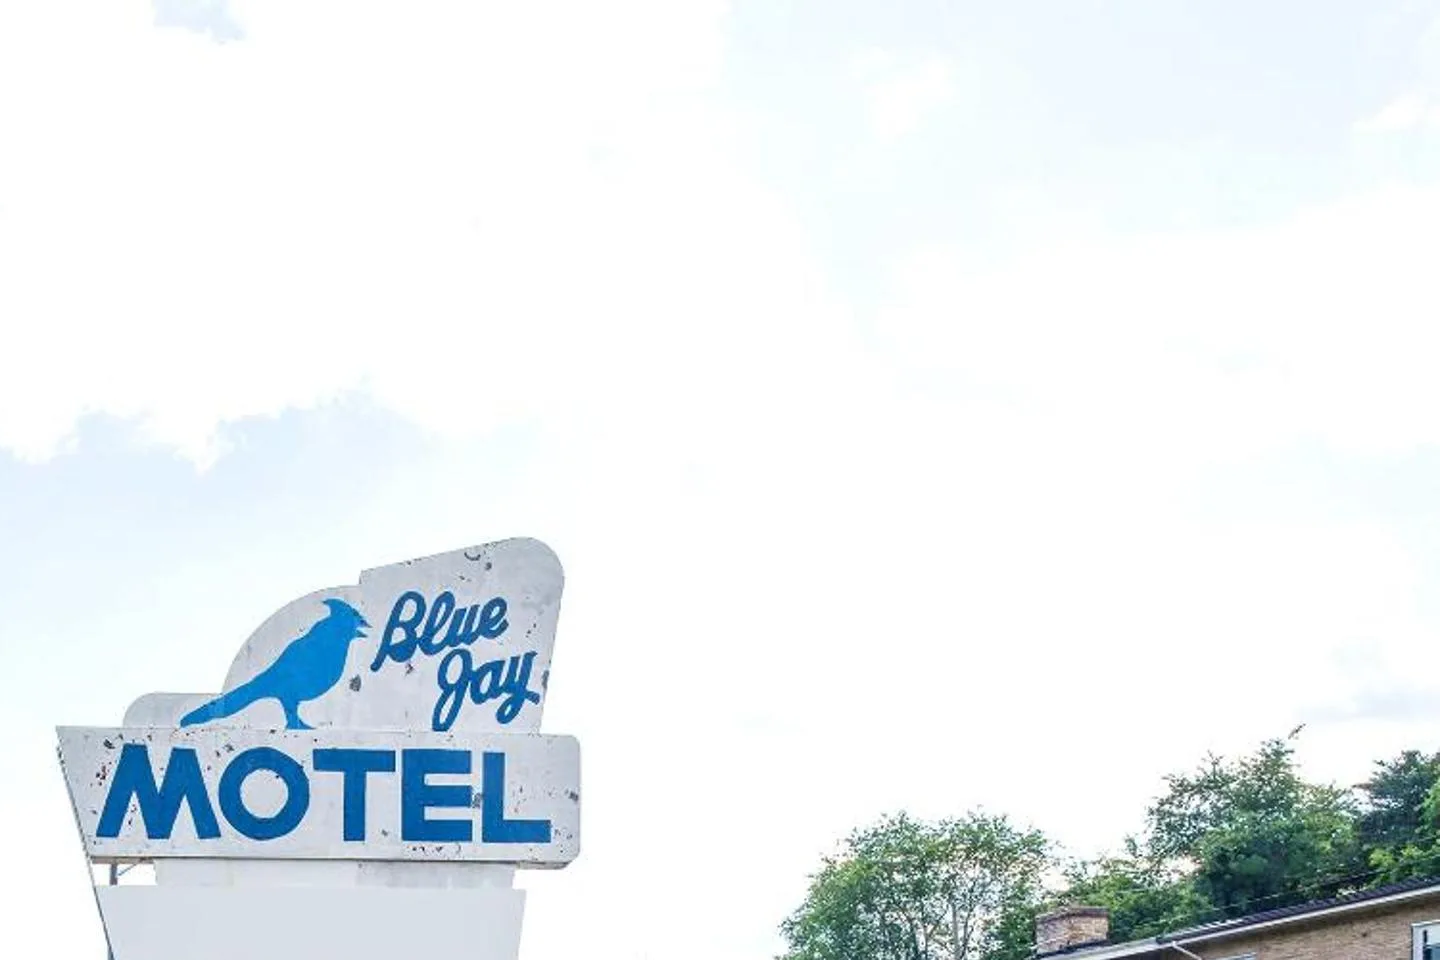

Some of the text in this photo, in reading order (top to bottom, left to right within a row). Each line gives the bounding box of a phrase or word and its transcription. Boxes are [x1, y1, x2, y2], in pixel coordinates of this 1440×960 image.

[371, 591, 509, 672] Blue
[431, 649, 540, 732] Jay
[95, 743, 552, 844] MOTEL
